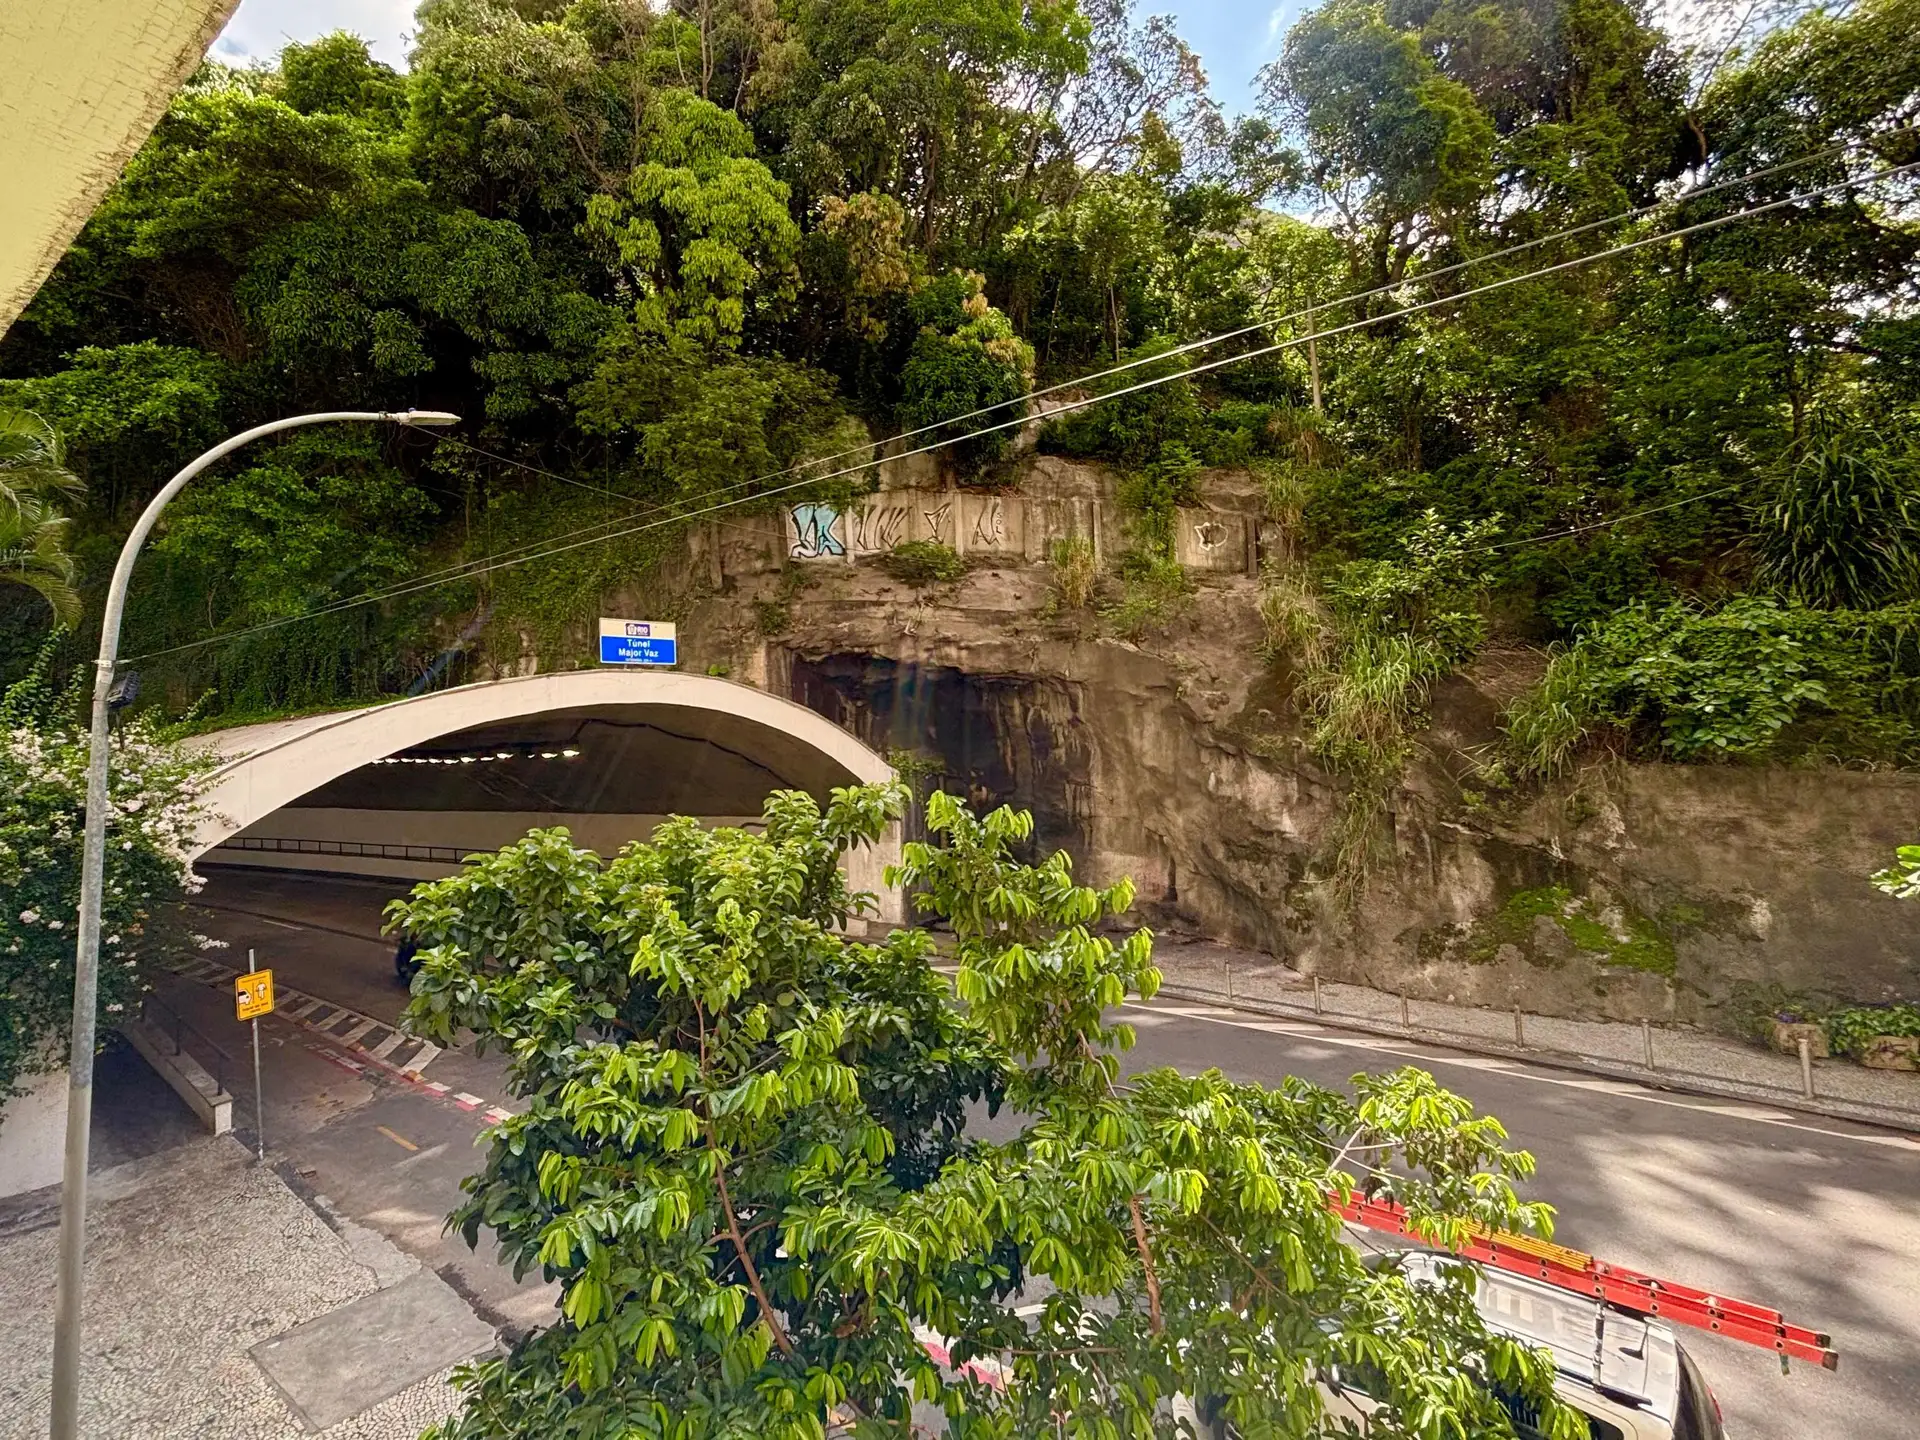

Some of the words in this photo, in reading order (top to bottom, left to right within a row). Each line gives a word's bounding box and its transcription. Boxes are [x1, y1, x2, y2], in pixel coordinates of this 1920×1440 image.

[637, 626, 649, 634] RIO
[627, 639, 650, 648] Túnel
[618, 648, 642, 657] Major
[644, 649, 659, 657] Vaz
